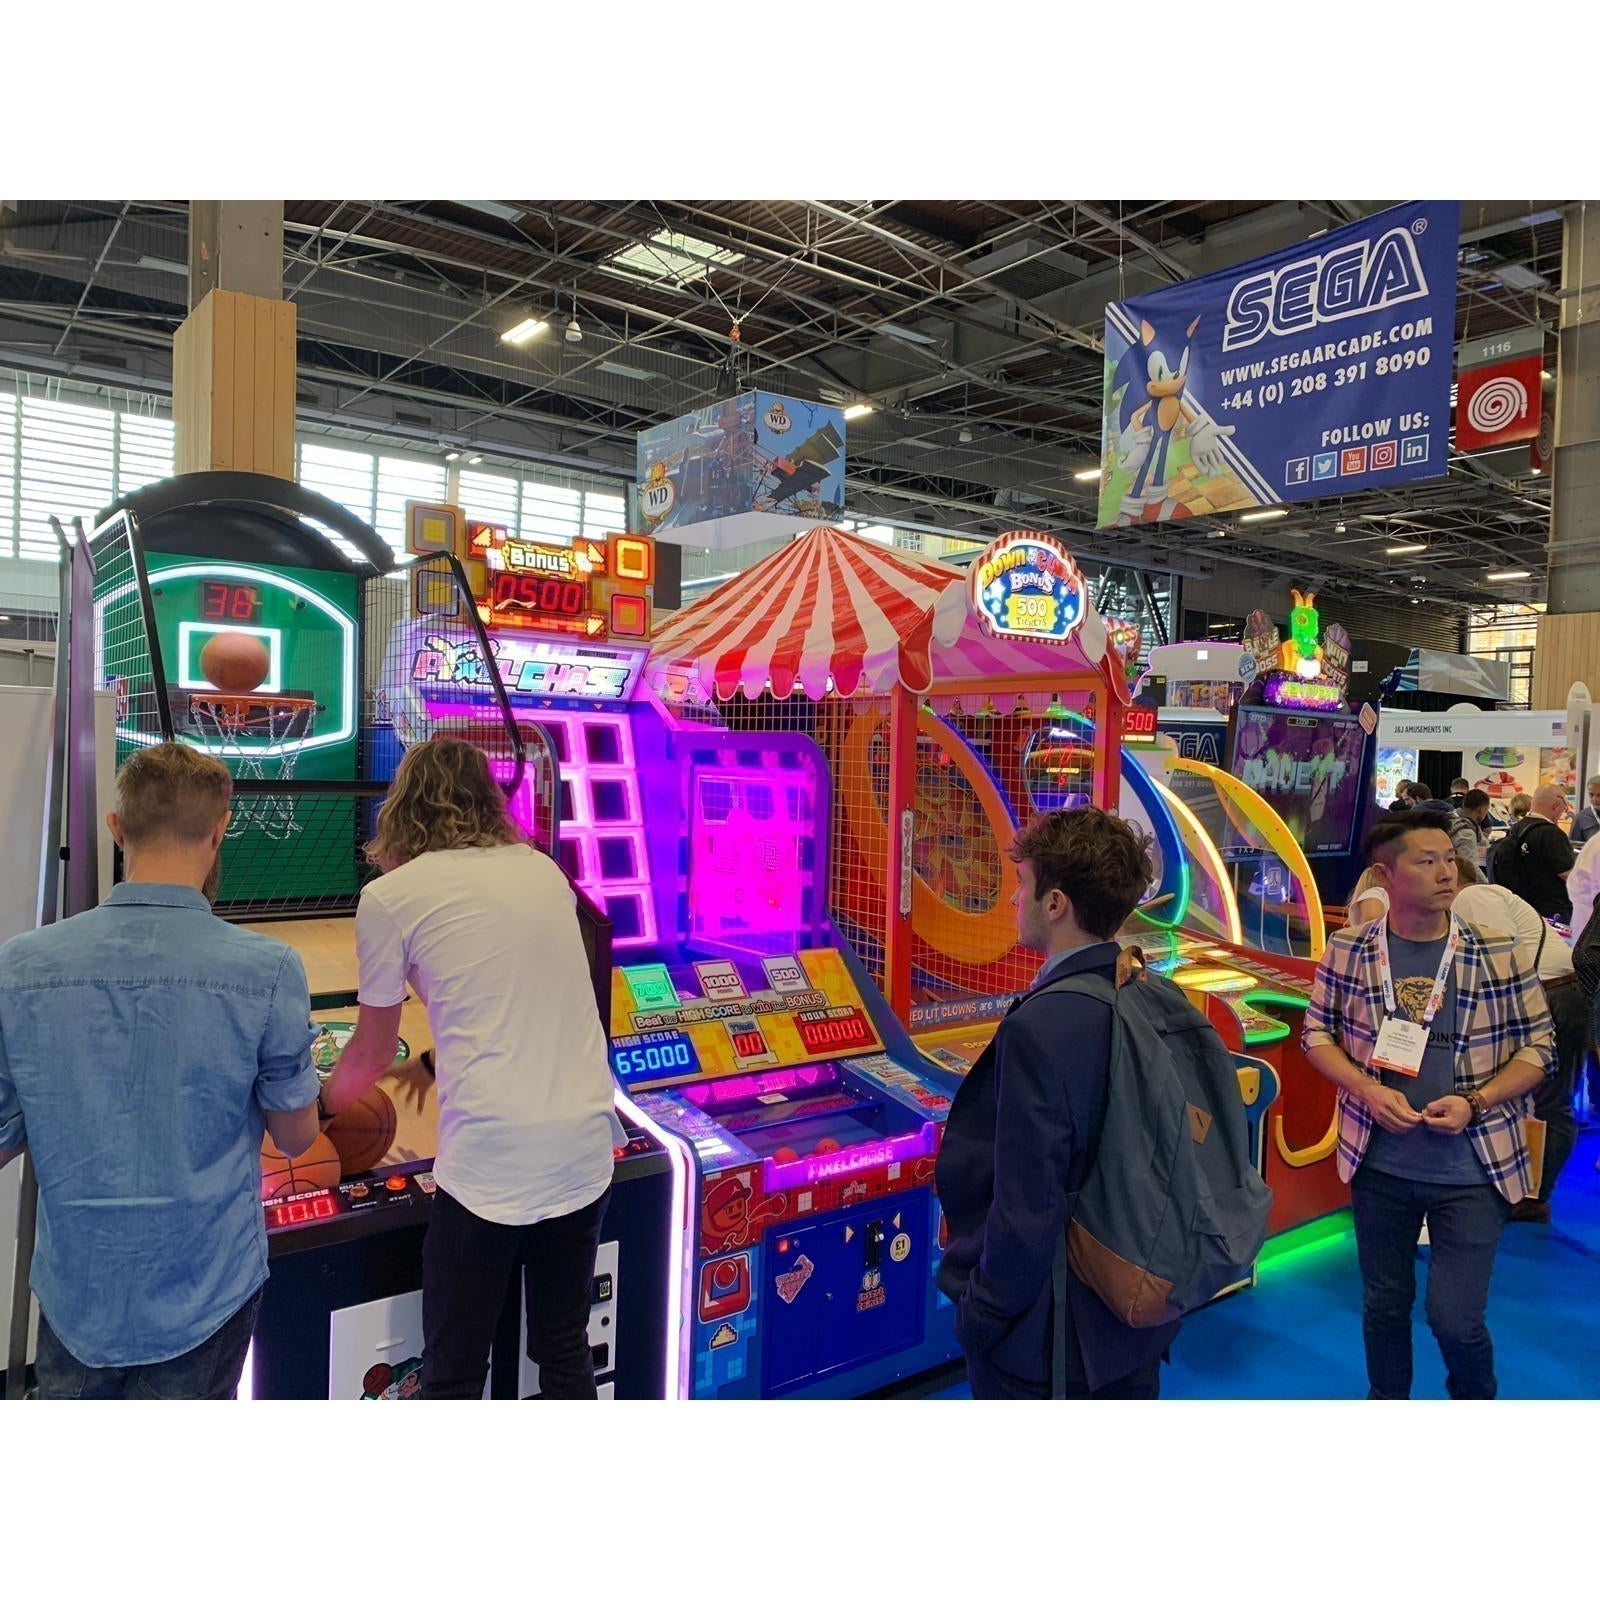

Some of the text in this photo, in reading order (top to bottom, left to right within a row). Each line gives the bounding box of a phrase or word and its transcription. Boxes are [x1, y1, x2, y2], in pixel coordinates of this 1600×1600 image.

[1222, 227, 1429, 352] SEGA
[1220, 317, 1434, 387] WWW.SEGAARCADE.COM
[1482, 341, 1512, 357] 1116
[1221, 346, 1431, 412] +44 (0) 208 391 8090
[769, 414, 787, 426] WD
[1321, 413, 1431, 448] FOLLOW US:
[648, 486, 668, 507] WD
[508, 548, 570, 571] Bonus
[1016, 597, 1048, 618] 500
[1016, 617, 1047, 627] TICKETS
[516, 661, 630, 697] CHASE
[1126, 712, 1154, 731] 500
[1394, 725, 1453, 734] J&J AMUSEMENTS INC
[702, 974, 739, 989] 1000
[770, 968, 800, 981] 500
[633, 982, 668, 998] 700
[636, 1014, 663, 1029] Beat
[676, 1008, 705, 1023] HIGH
[705, 1004, 741, 1020] SCORE
[751, 1001, 772, 1013] win
[786, 993, 826, 1009] BONUS
[800, 1007, 855, 1022] YOUR SCORE
[910, 1009, 923, 1022] ED
[926, 1007, 939, 1019] LIT
[942, 1003, 977, 1017] CLOWNS
[979, 1000, 993, 1011] are
[643, 1030, 680, 1043] SCORE
[805, 1019, 865, 1045] 00000
[735, 1034, 763, 1057] 00
[615, 1043, 690, 1075] 65000
[848, 1146, 894, 1168] CHASE
[287, 1189, 330, 1201] SCORE
[389, 1194, 411, 1202] START
[895, 1239, 905, 1251] £1
